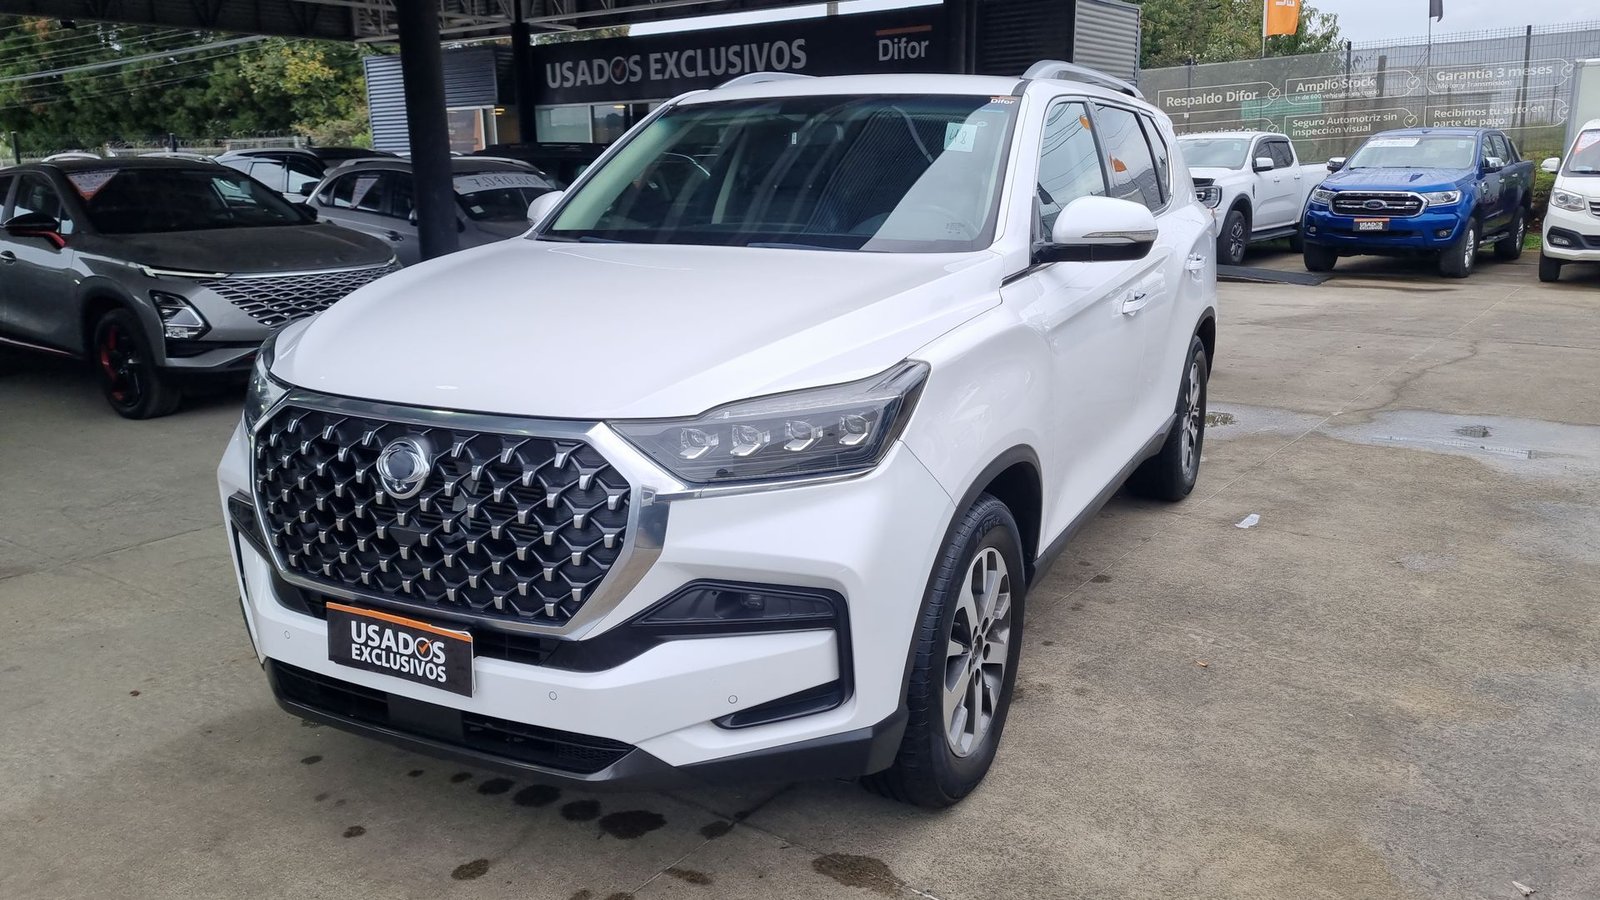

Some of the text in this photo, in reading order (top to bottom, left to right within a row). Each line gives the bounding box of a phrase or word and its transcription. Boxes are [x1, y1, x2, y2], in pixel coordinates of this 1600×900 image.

[878, 37, 929, 61] Difor
[546, 38, 807, 89] USADOS EXCLUSIVOS
[1496, 68, 1505, 78] 3
[1508, 65, 1553, 77] meses
[1296, 77, 1377, 93] Amplio Stock
[1166, 90, 1259, 108] Respaldo Difor
[1434, 108, 1487, 118] Recibimos
[1503, 106, 1528, 115] auto
[1530, 105, 1545, 113] en
[1292, 112, 1398, 129] Seguro Automotriz sin
[1434, 117, 1505, 128] parte de pago
[1293, 124, 1371, 137] inspección visual
[351, 620, 446, 665] USADOS
[351, 643, 447, 683] EXCLUSIVOS
